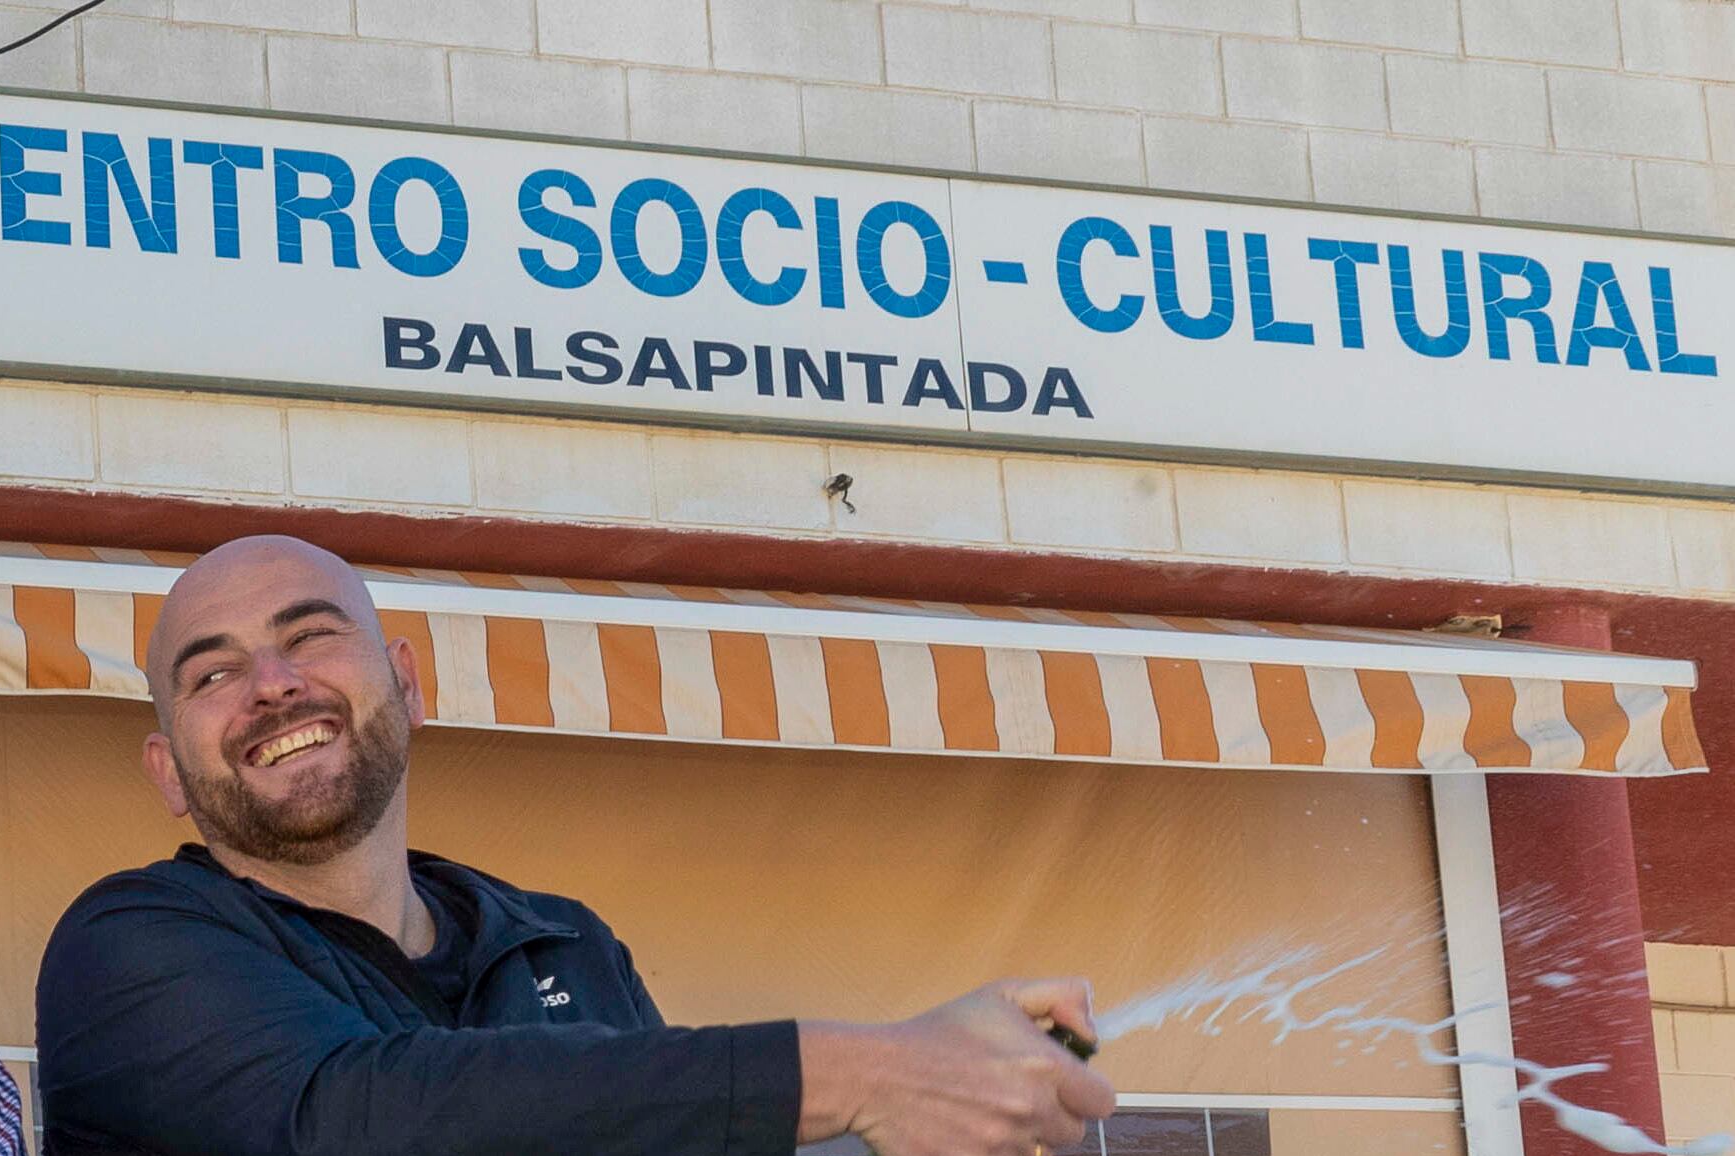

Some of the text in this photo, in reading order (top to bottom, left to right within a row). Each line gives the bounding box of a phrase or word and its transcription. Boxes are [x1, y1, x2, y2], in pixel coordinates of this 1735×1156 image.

[517, 168, 952, 319] SOCIO
[1056, 216, 1719, 378] CULTURAL
[382, 316, 1095, 420] BALSAPINTADA
